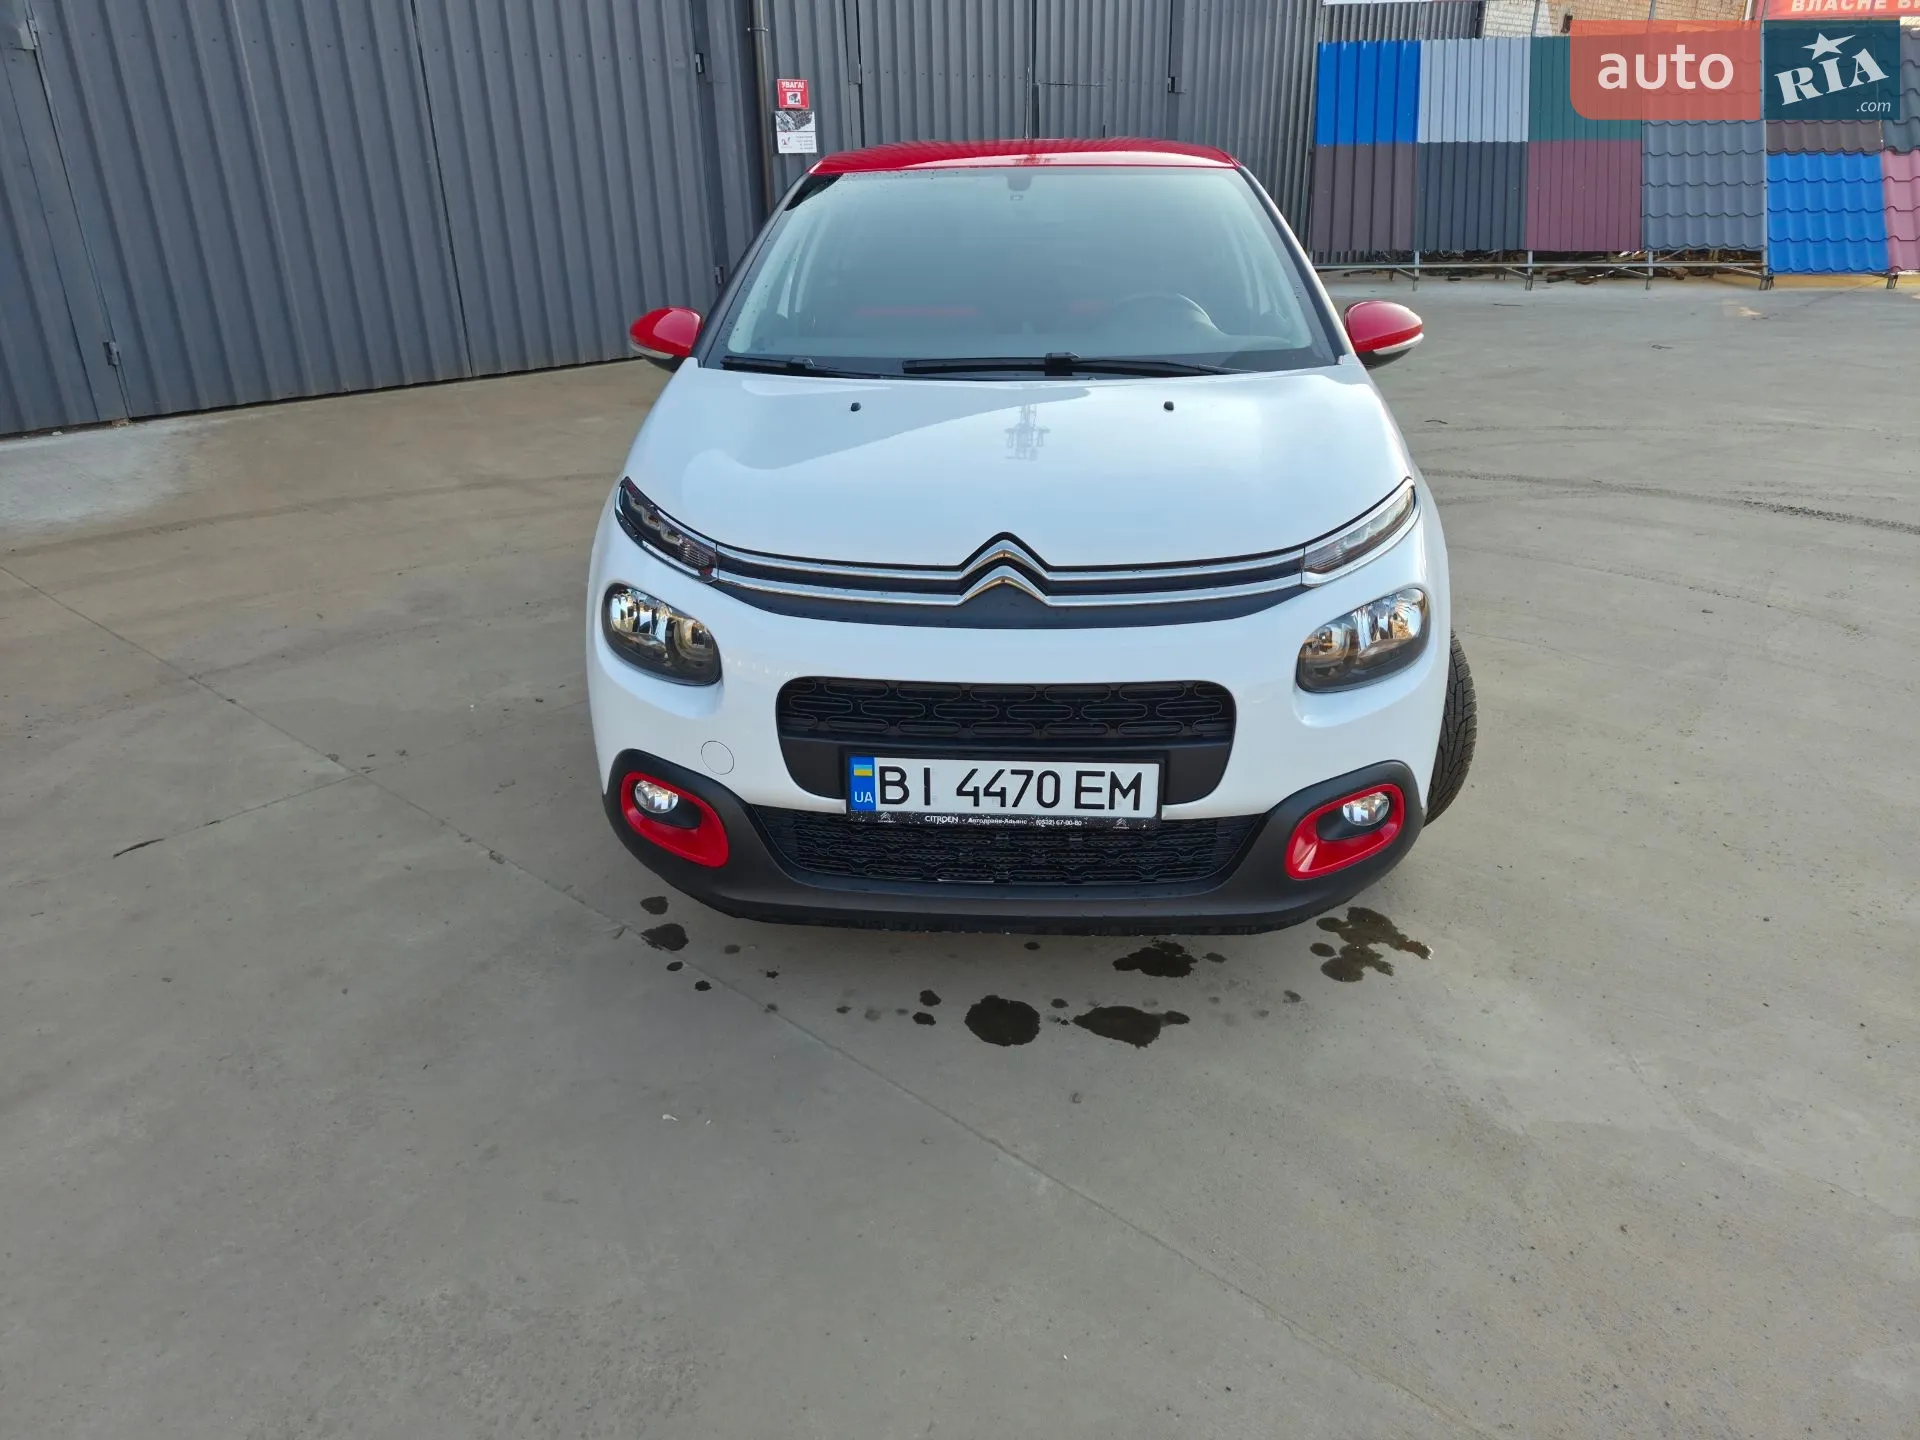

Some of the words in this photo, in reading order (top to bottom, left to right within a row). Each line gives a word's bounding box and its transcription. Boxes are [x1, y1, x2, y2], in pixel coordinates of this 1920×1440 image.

[1791, 0, 1887, 12] ВЛАСНЕ
[878, 765, 931, 807] BI
[956, 767, 1061, 809] 4470
[1074, 770, 1143, 811] EM
[854, 791, 874, 804] UA
